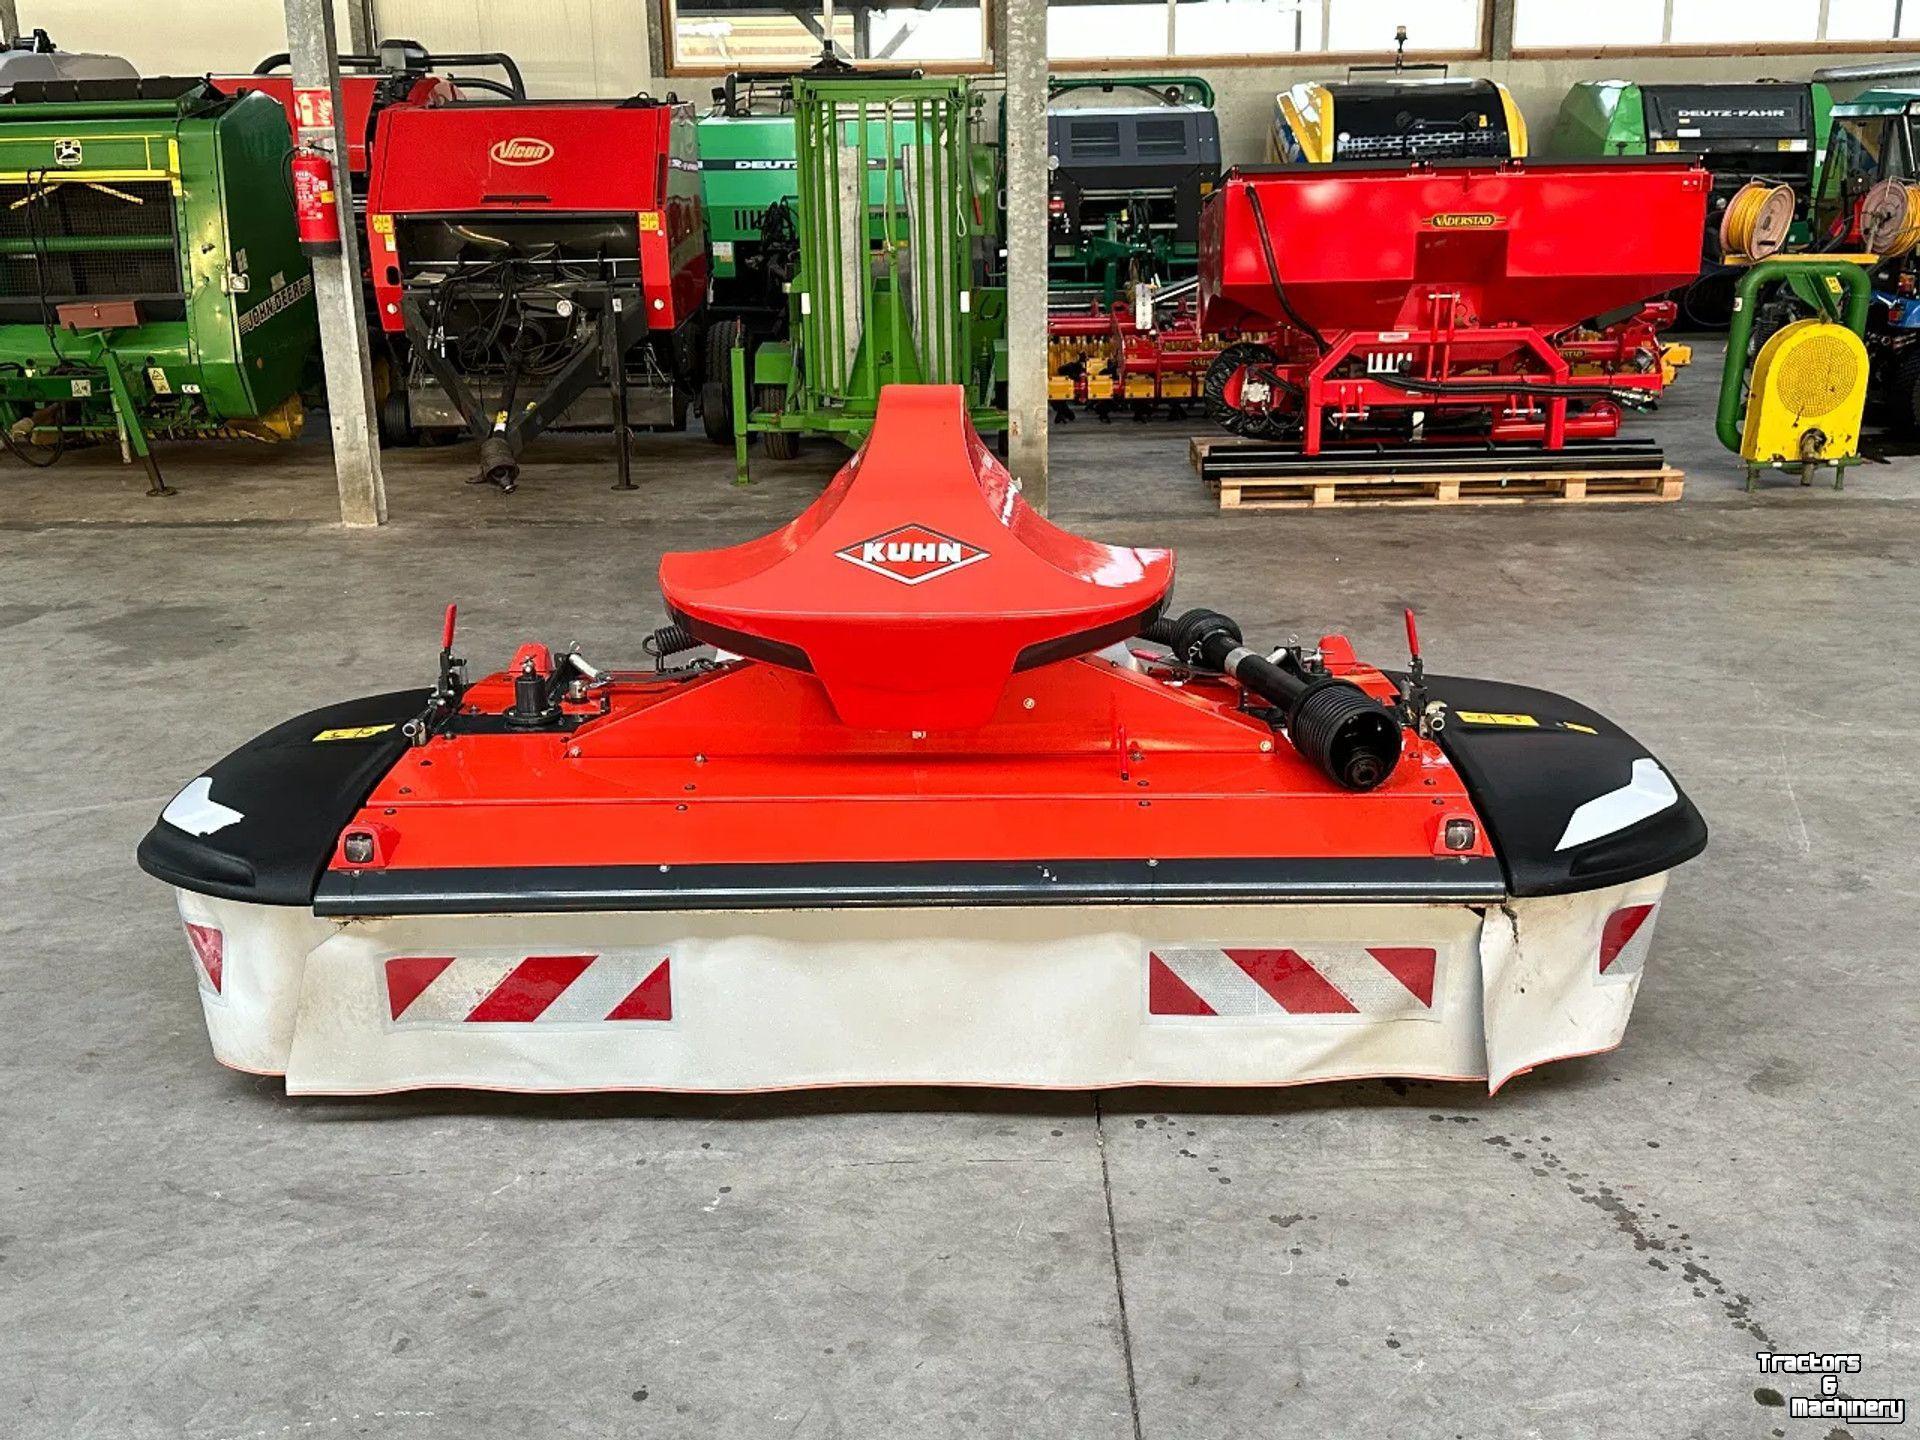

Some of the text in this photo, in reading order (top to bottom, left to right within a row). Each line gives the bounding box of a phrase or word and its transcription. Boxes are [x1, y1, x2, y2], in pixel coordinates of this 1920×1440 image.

[1678, 109, 1785, 117] DEUTZ-FAHR
[499, 140, 547, 159] Vicon
[248, 279, 307, 331] JOHN DEERE
[862, 542, 962, 563] KUHN
